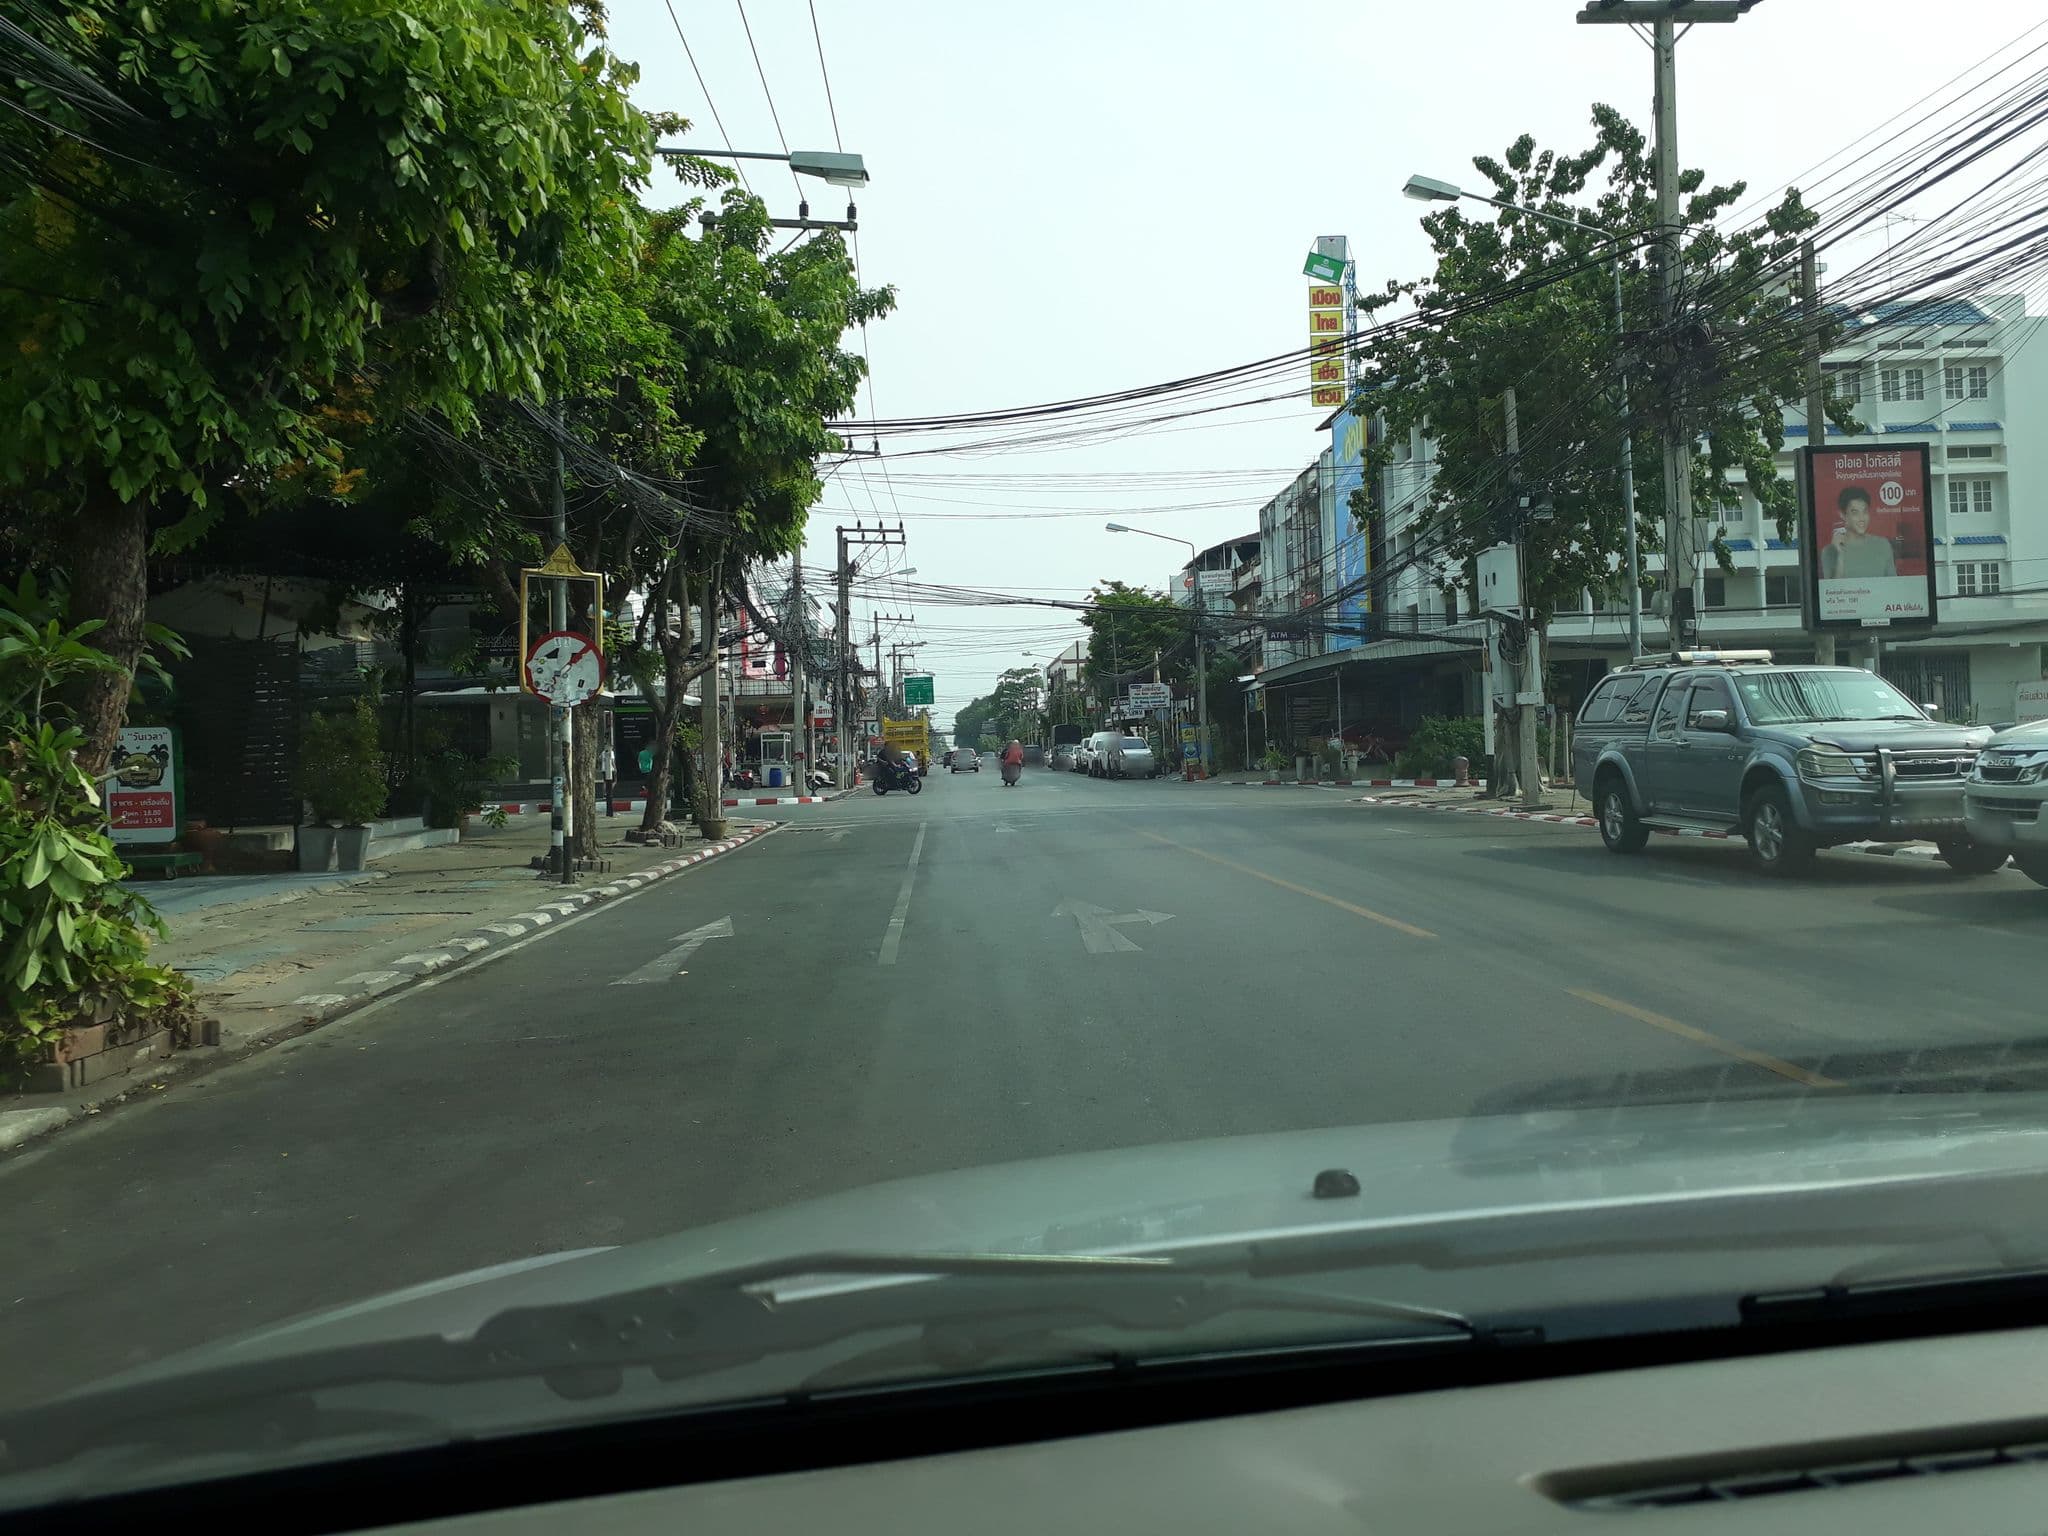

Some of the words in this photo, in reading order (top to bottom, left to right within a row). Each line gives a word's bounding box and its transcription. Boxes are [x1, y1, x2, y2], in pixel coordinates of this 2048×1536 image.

[1312, 288, 1341, 305] เมือง
[1314, 313, 1338, 331] ไทย
[1835, 454, 1863, 469] เอไอเอ
[1881, 486, 1902, 500] 100
[1885, 603, 1903, 612] AIA
[1270, 630, 1289, 640] ATM
[1987, 757, 2016, 768] ISUZU
[122, 810, 140, 818] Open
